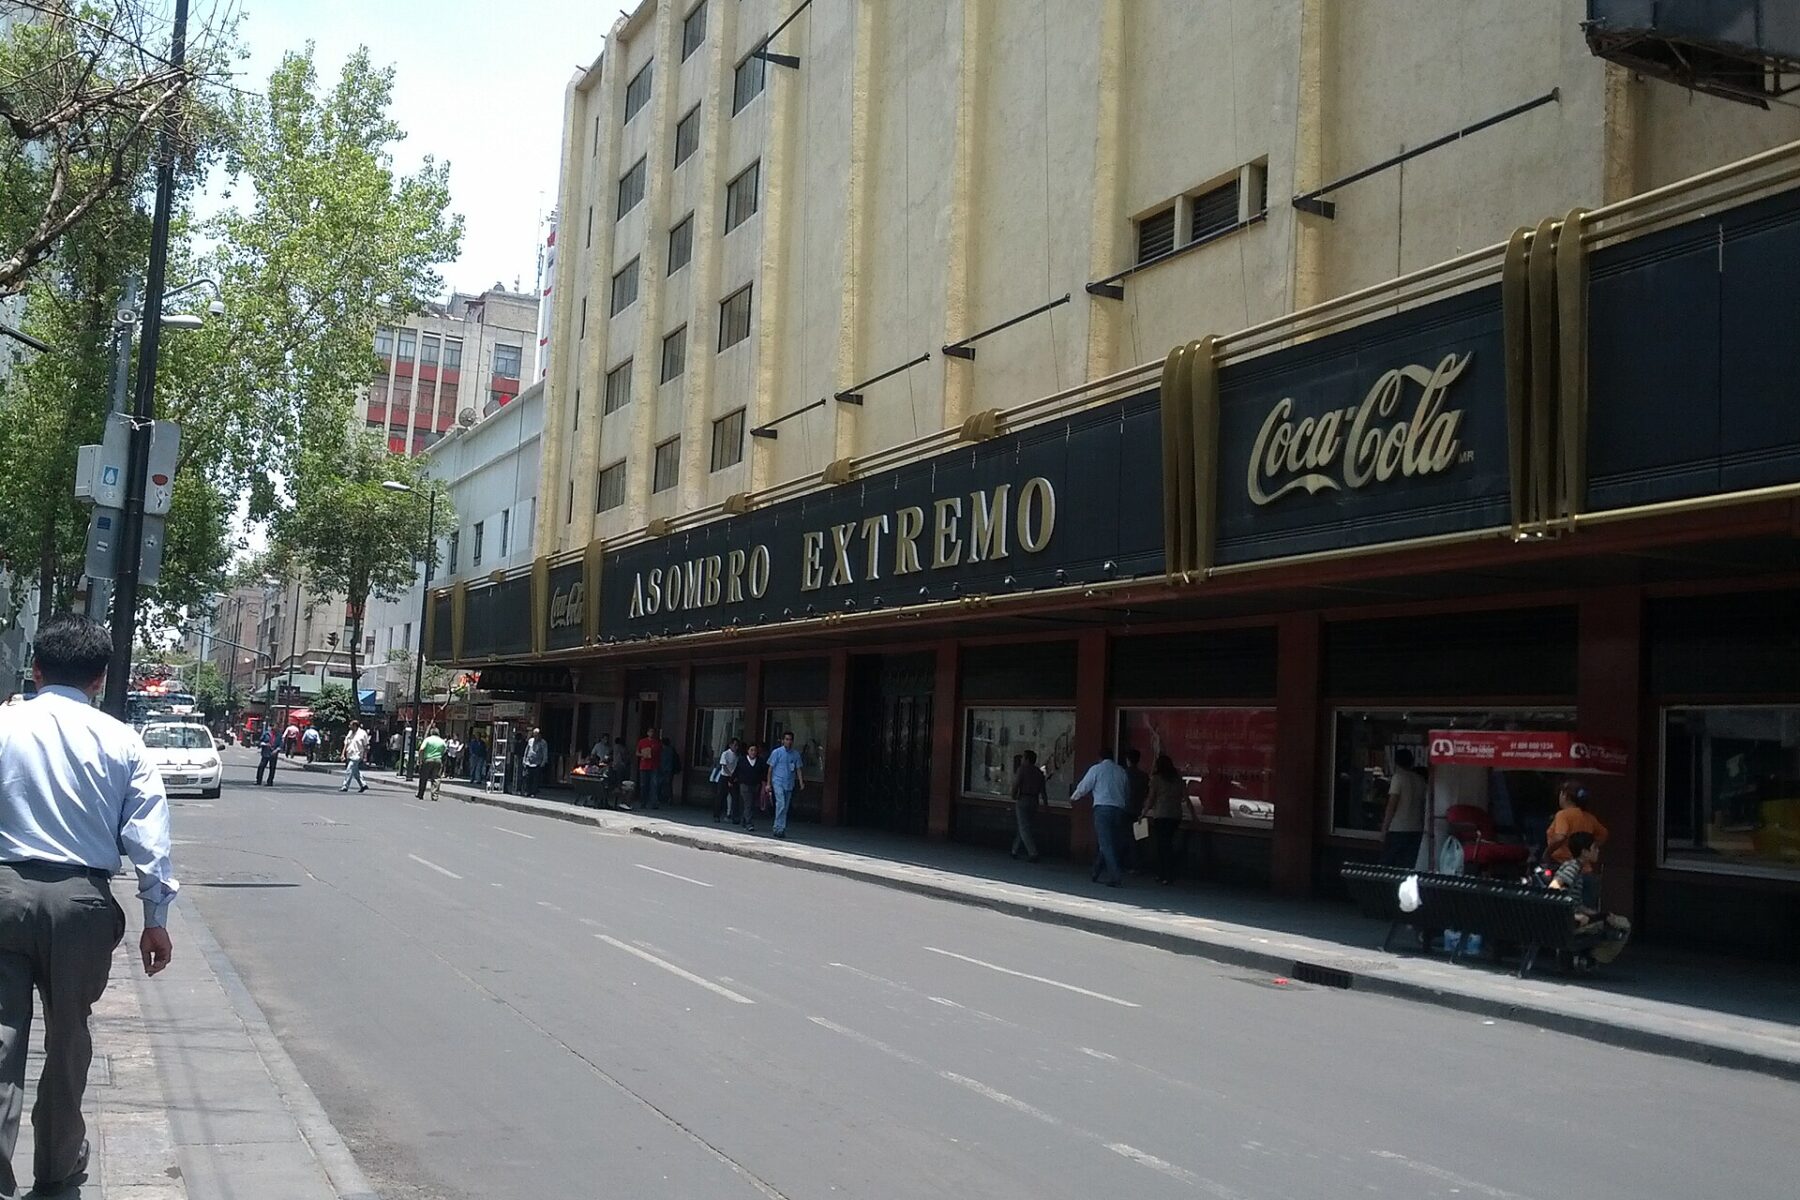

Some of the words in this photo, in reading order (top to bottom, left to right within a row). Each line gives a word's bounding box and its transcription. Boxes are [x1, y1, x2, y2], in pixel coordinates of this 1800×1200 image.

[1458, 450, 1475, 464] MR
[627, 544, 770, 619] ASOMBRO
[801, 476, 1056, 592] EXTREMO
